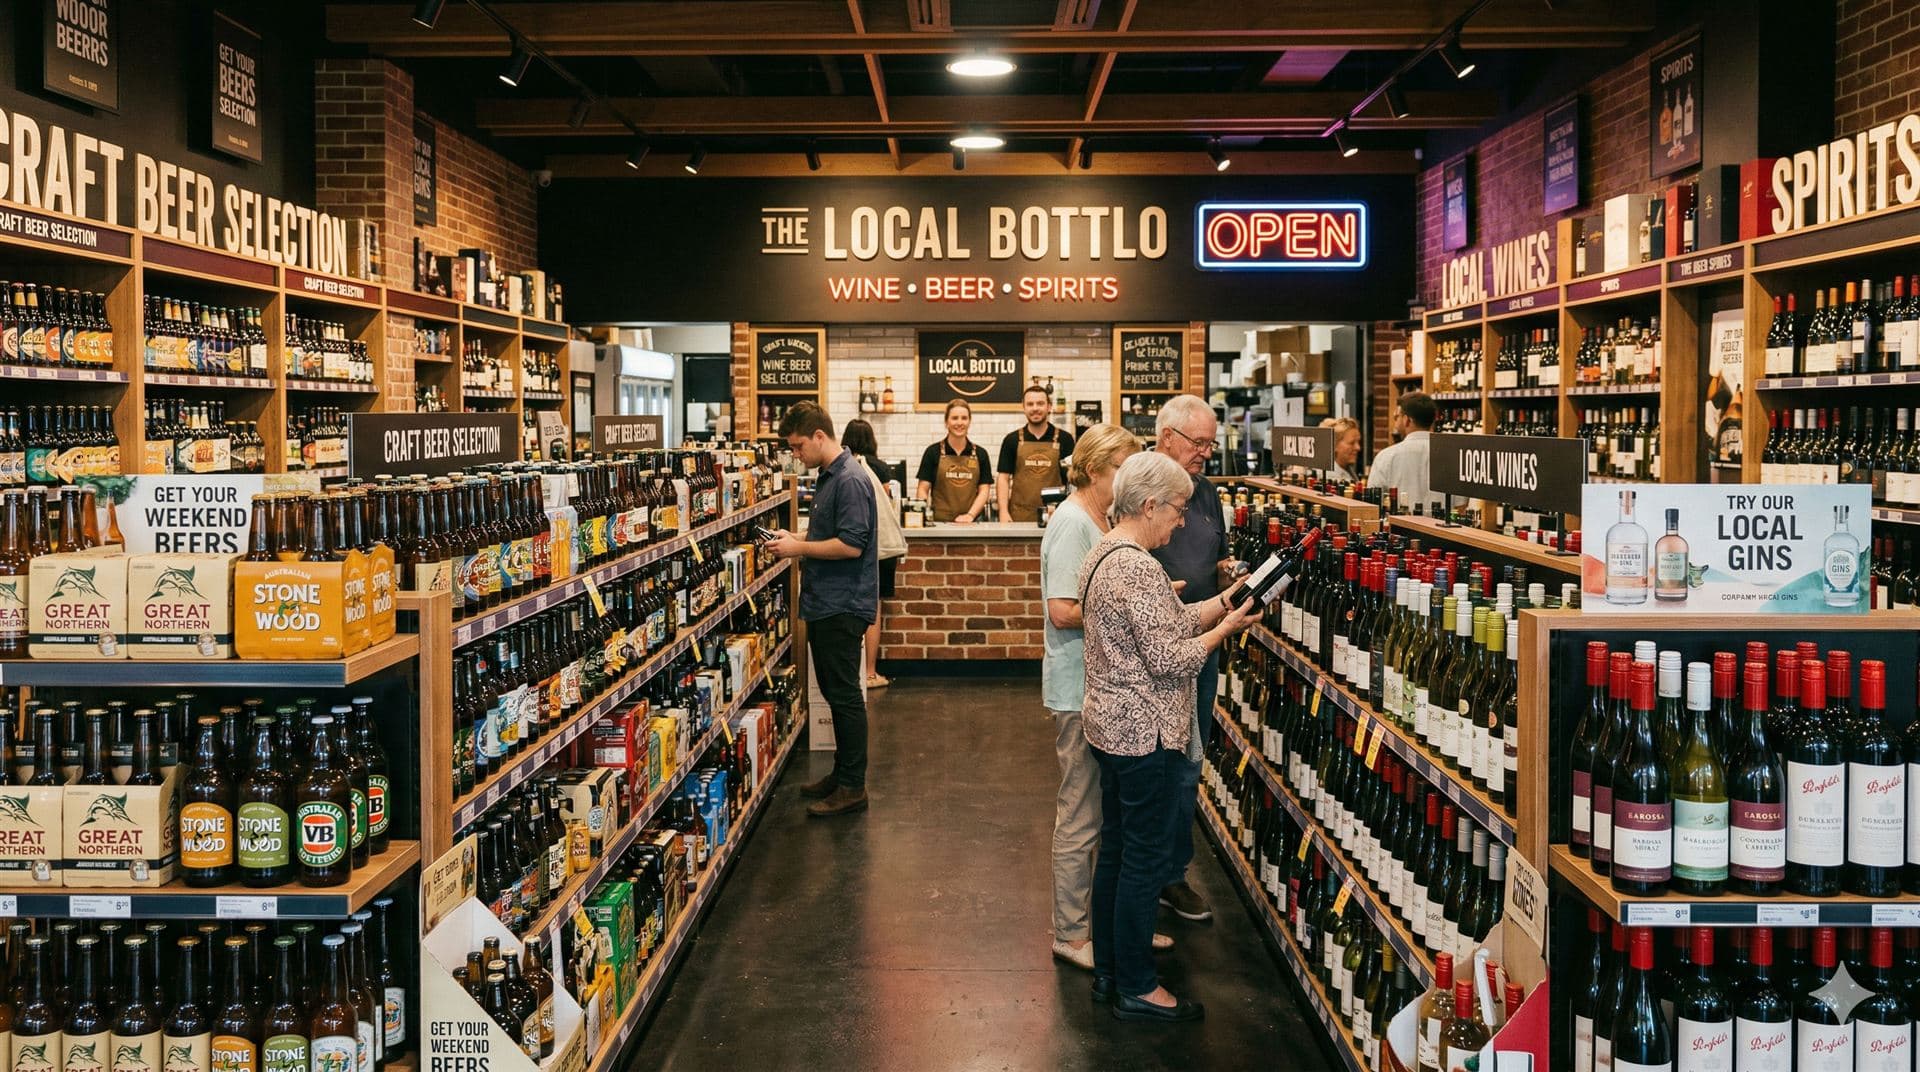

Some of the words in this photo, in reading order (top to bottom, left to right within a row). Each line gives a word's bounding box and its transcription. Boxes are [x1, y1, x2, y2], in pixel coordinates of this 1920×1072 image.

[56, 22, 109, 67] BEERRS
[219, 43, 234, 65] GET
[236, 50, 255, 76] YOUR
[1661, 52, 1694, 84] SPIRITS
[219, 61, 256, 107] BEERS
[219, 96, 256, 127] SELECTION
[1772, 114, 1920, 234] SPIRITS
[137, 153, 216, 249] BEER
[223, 184, 348, 278] SELECTION
[25, 217, 49, 238] BEER
[50, 222, 97, 247] SELECTION
[762, 217, 808, 245] THE
[824, 206, 970, 259] LOCAL
[990, 206, 1168, 259] BOTTLO
[1206, 211, 1357, 259] OPEN
[1442, 251, 1487, 309] LOCAL
[1492, 230, 1550, 297] WINES
[828, 277, 901, 299] WINE
[925, 277, 996, 299] BEER
[1018, 277, 1118, 300] SPIRITS
[762, 359, 786, 370] WINE
[790, 359, 811, 371] BEER
[928, 358, 967, 374] LOCAL
[969, 358, 1016, 374] BOTTLO
[384, 429, 420, 464] CRAFT
[424, 427, 450, 459] BEER
[453, 426, 500, 457] SELECTION
[1459, 448, 1493, 485] LOCAL
[1496, 450, 1538, 491] WINES
[154, 486, 184, 503] GET
[192, 486, 238, 503] YOUR
[1727, 495, 1757, 510] TRY
[1762, 495, 1794, 511] OUR
[145, 507, 248, 528] WEEKEND
[1718, 514, 1803, 541] LOCAL
[1728, 545, 1793, 572] GINS
[254, 583, 321, 605] STONE
[45, 603, 110, 618] GREAT
[144, 603, 210, 618] GREAT
[255, 608, 321, 631] WOOD
[45, 620, 110, 629] NORTHERN
[144, 620, 210, 629] NORTHERN
[183, 817, 226, 833] STONE
[240, 817, 282, 833] STONE
[304, 825, 334, 842] VB
[78, 830, 143, 844] GREAT
[183, 838, 226, 852] WOOD
[240, 838, 282, 852] WOOD
[78, 846, 143, 855] NORTHERN
[431, 1021, 453, 1036] GET
[457, 1021, 488, 1036] YOUR
[213, 1049, 250, 1062] STONE
[265, 1046, 305, 1062] STONE
[431, 1039, 490, 1053] WEEKEND
